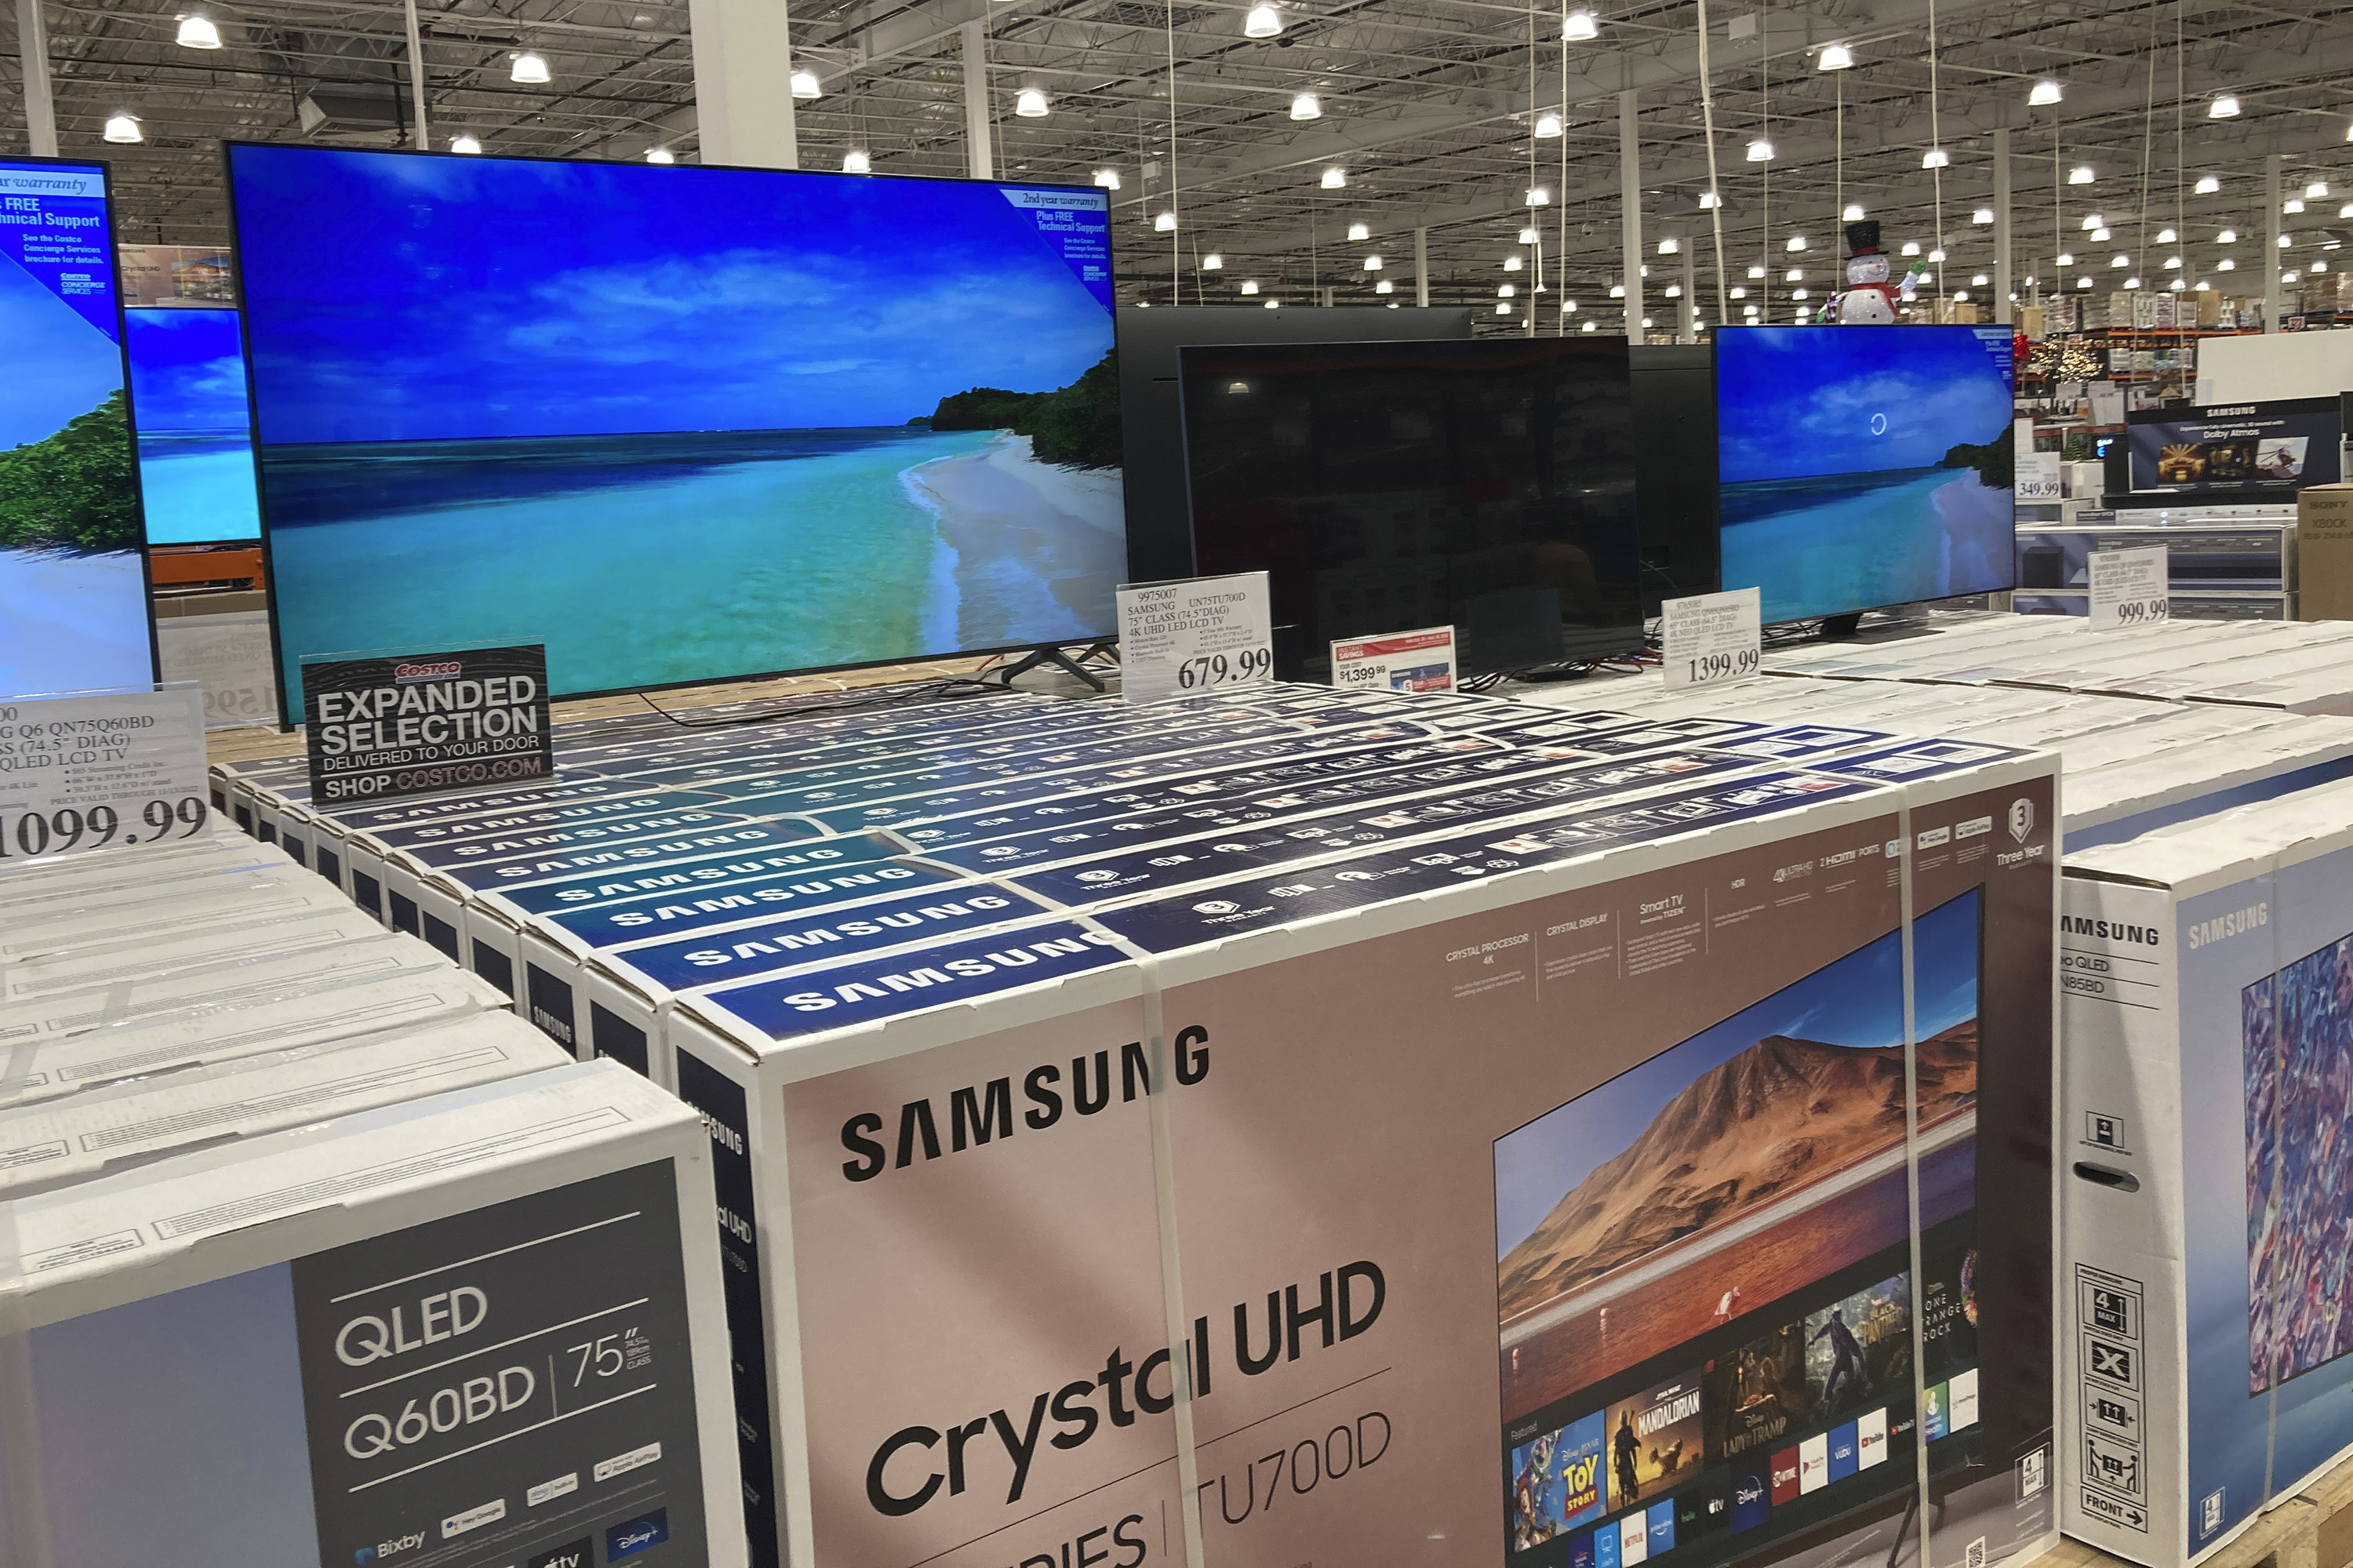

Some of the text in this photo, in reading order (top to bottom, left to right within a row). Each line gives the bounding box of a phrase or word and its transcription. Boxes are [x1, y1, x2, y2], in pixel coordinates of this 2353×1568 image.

[13, 179, 87, 195] warranty
[5, 197, 41, 211] FREE
[1023, 192, 1099, 209] 2nd year warranty
[0, 212, 100, 230] hnical Support
[1036, 210, 1074, 222] Plus FREE
[1037, 220, 1105, 235] Technical Support
[24, 244, 101, 254] Concierge Services
[2206, 406, 2256, 417] SAMSUNG
[2203, 428, 2260, 440] Dolby Atmos
[2019, 482, 2059, 496] 349.99
[2309, 500, 2348, 509] SONY
[1127, 592, 1246, 616] SAMSUNG UN75TU700D
[1137, 588, 1177, 602] 9975007
[1145, 613, 1176, 624] CLASS
[1669, 609, 1701, 620] SAMSUNG
[2118, 598, 2166, 625] 999.99
[1129, 616, 1225, 637] 4K UHD LED LCD TV
[1680, 618, 1700, 628] CLASS
[1711, 623, 1726, 632] LCD
[1726, 621, 1734, 630] TV
[1337, 644, 1364, 654] INSTANT
[1338, 650, 1364, 660] SAVINGS
[395, 660, 462, 678] COSTCO
[1178, 648, 1271, 689] 679.99
[1340, 665, 1386, 683] $1,399 99
[1688, 649, 1759, 683] 1399.99
[1405, 682, 1410, 691] 5
[318, 675, 536, 724] EXPANDED
[20, 723, 44, 740] Q6
[49, 715, 155, 736] QN75Q60BD
[320, 705, 538, 755] SELECTION
[78, 733, 131, 750] DIAG)
[1, 748, 128, 773] QLED LCD TV
[323, 749, 413, 771] DELIVERED
[416, 746, 438, 761] TO
[442, 740, 488, 758] YOUR
[493, 735, 540, 752] DOOR
[325, 756, 542, 799] SHOP COSTCO.COM
[50, 789, 156, 806] PRICE VALID THROUGH
[373, 786, 609, 822] SAMSUNG
[413, 798, 661, 839] SAMSUNG
[2017, 805, 2026, 826] 3
[0, 796, 206, 858] 1099.99
[453, 813, 714, 857] SAMSUNG
[494, 829, 775, 878] SAMSUNG
[1820, 858, 1825, 868] 2
[1858, 843, 1880, 857] PORTS
[1996, 850, 2023, 866] Three
[2024, 845, 2046, 859] Year
[554, 849, 846, 903] SAMSUNG
[1080, 873, 1151, 890] Three Year
[1731, 878, 1746, 890] HDR
[609, 868, 916, 927] SAMSUNG
[1640, 893, 1684, 915] Smart TV
[1201, 905, 1275, 925] Three Year
[1546, 912, 1609, 937] CRYSTAL DISPLAY
[683, 895, 1012, 967] SAMSUNG
[2060, 915, 2159, 946] AMSUNG
[2188, 903, 2268, 950] SAMSUNG
[1446, 933, 1529, 963] CRYSTAL PROCESSOR
[1482, 954, 1495, 966] 4K
[2075, 956, 2110, 973] QLED
[782, 930, 1129, 1013] SAMSUNG
[2060, 976, 2105, 994] N85BD
[533, 1005, 572, 1044] SAMSUNG
[839, 1024, 1211, 1183] SAMSUNG
[729, 1210, 753, 1244] UHD
[1926, 1294, 1947, 1312] ONE
[2096, 1292, 2110, 1308] 4
[334, 1286, 489, 1367] QLED
[2097, 1311, 2116, 1323] MAX
[1923, 1322, 1951, 1343] ROCK
[627, 1355, 653, 1370] CLASS
[865, 1259, 1387, 1518] Crystal UHD
[343, 1366, 536, 1460] Q60BD
[1638, 1391, 1700, 1439] MANDALORIAN
[1511, 1421, 1538, 1442] Featured
[1723, 1417, 1788, 1458] LADY TRAMP
[1186, 1410, 1393, 1538] TU700D
[1563, 1453, 1599, 1497] TOY
[2024, 1457, 2033, 1475] 4
[1567, 1492, 1597, 1512] STORY
[1736, 1488, 1764, 1505] Disney+
[2086, 1493, 2124, 1517] FRONT
[2206, 1499, 2214, 1513] 4
[377, 1530, 427, 1560] Bixby
[616, 1526, 660, 1550] Disney+
[1624, 1532, 1644, 1548] NETFLIX
